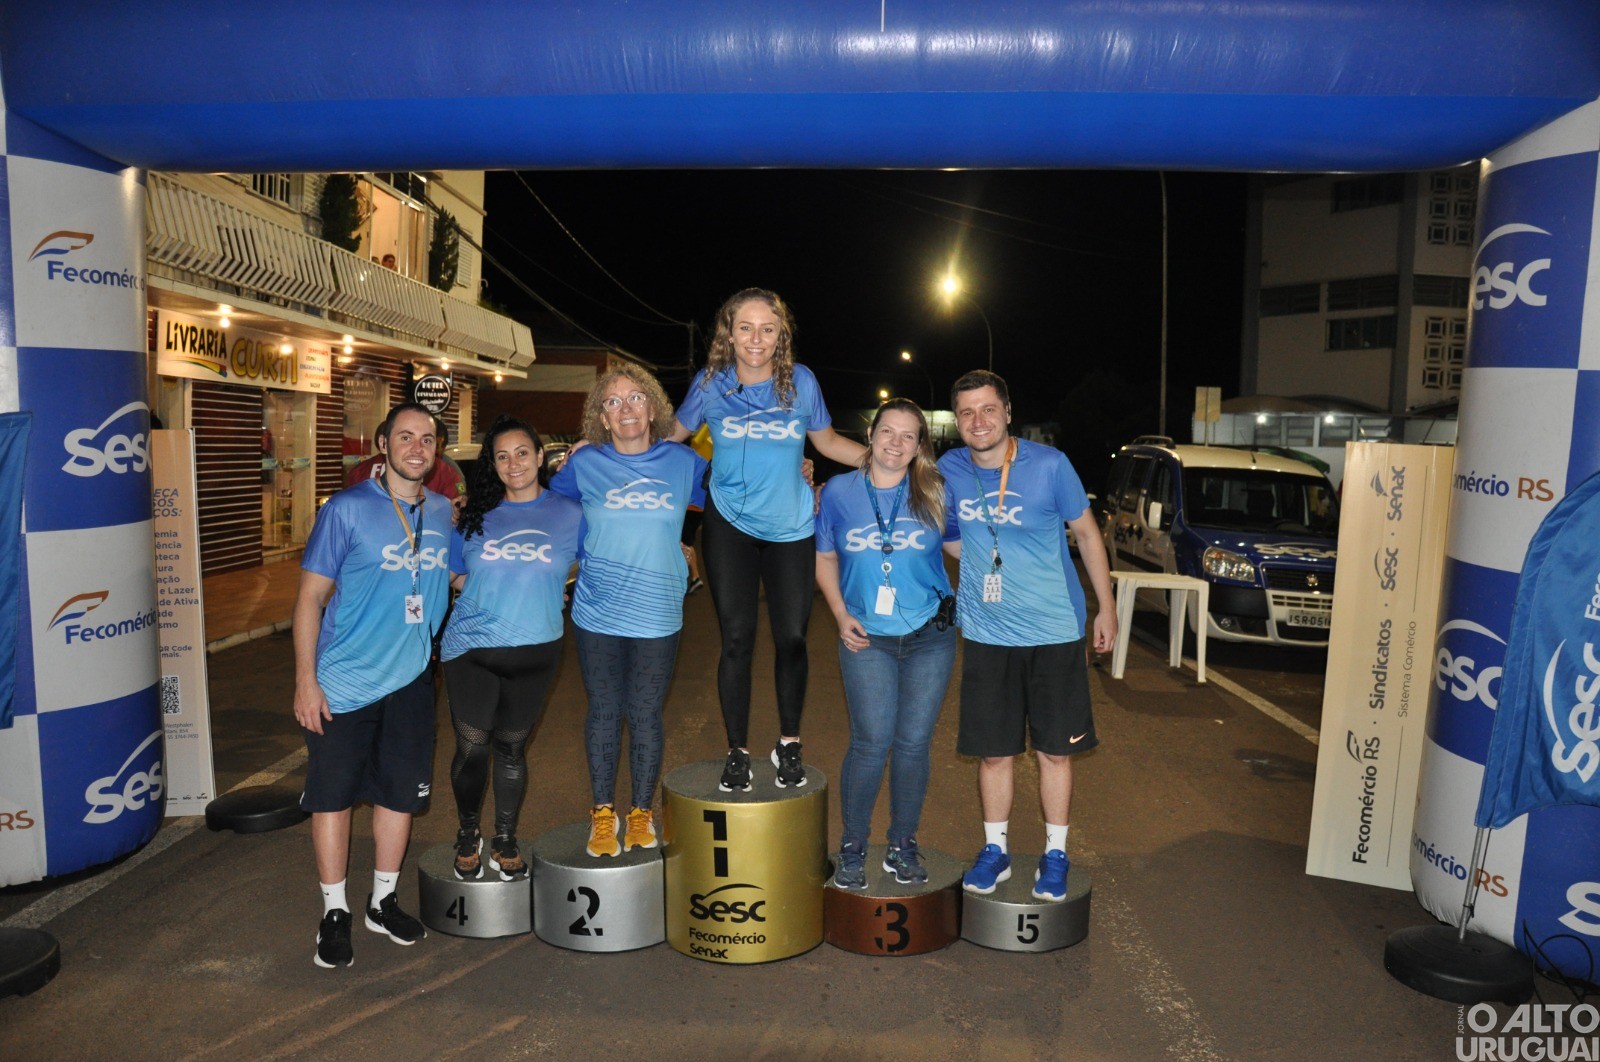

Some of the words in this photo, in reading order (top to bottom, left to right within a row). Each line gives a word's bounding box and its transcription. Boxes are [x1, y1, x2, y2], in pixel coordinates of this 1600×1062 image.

[231, 338, 298, 384] CURTI
[721, 416, 802, 439] Sesc
[604, 488, 675, 510] Sesc
[1387, 466, 1406, 521] Senac
[1518, 477, 1555, 502] RS
[959, 499, 1023, 525] Sesc
[480, 540, 551, 563] Sesc
[845, 528, 926, 552] Sesc
[380, 544, 448, 571] Sesc
[1381, 547, 1399, 592] Sesc
[168, 587, 194, 595] Lazer
[174, 598, 199, 606] Ativa
[1403, 620, 1417, 671] Comércio
[1369, 618, 1393, 710] Sindicatos
[1398, 674, 1412, 718] Sistema
[1364, 737, 1380, 760] RS
[0, 809, 35, 831] RS
[1352, 765, 1378, 864] Fecomércio
[703, 809, 728, 877] 1
[1474, 867, 1509, 897] RS
[446, 896, 469, 925] 4
[567, 886, 604, 936] 2
[689, 894, 766, 923] Sesc
[689, 927, 766, 944] Fecomércio
[874, 903, 910, 953] 3
[1016, 914, 1040, 944] 5
[690, 943, 728, 959] Senac
